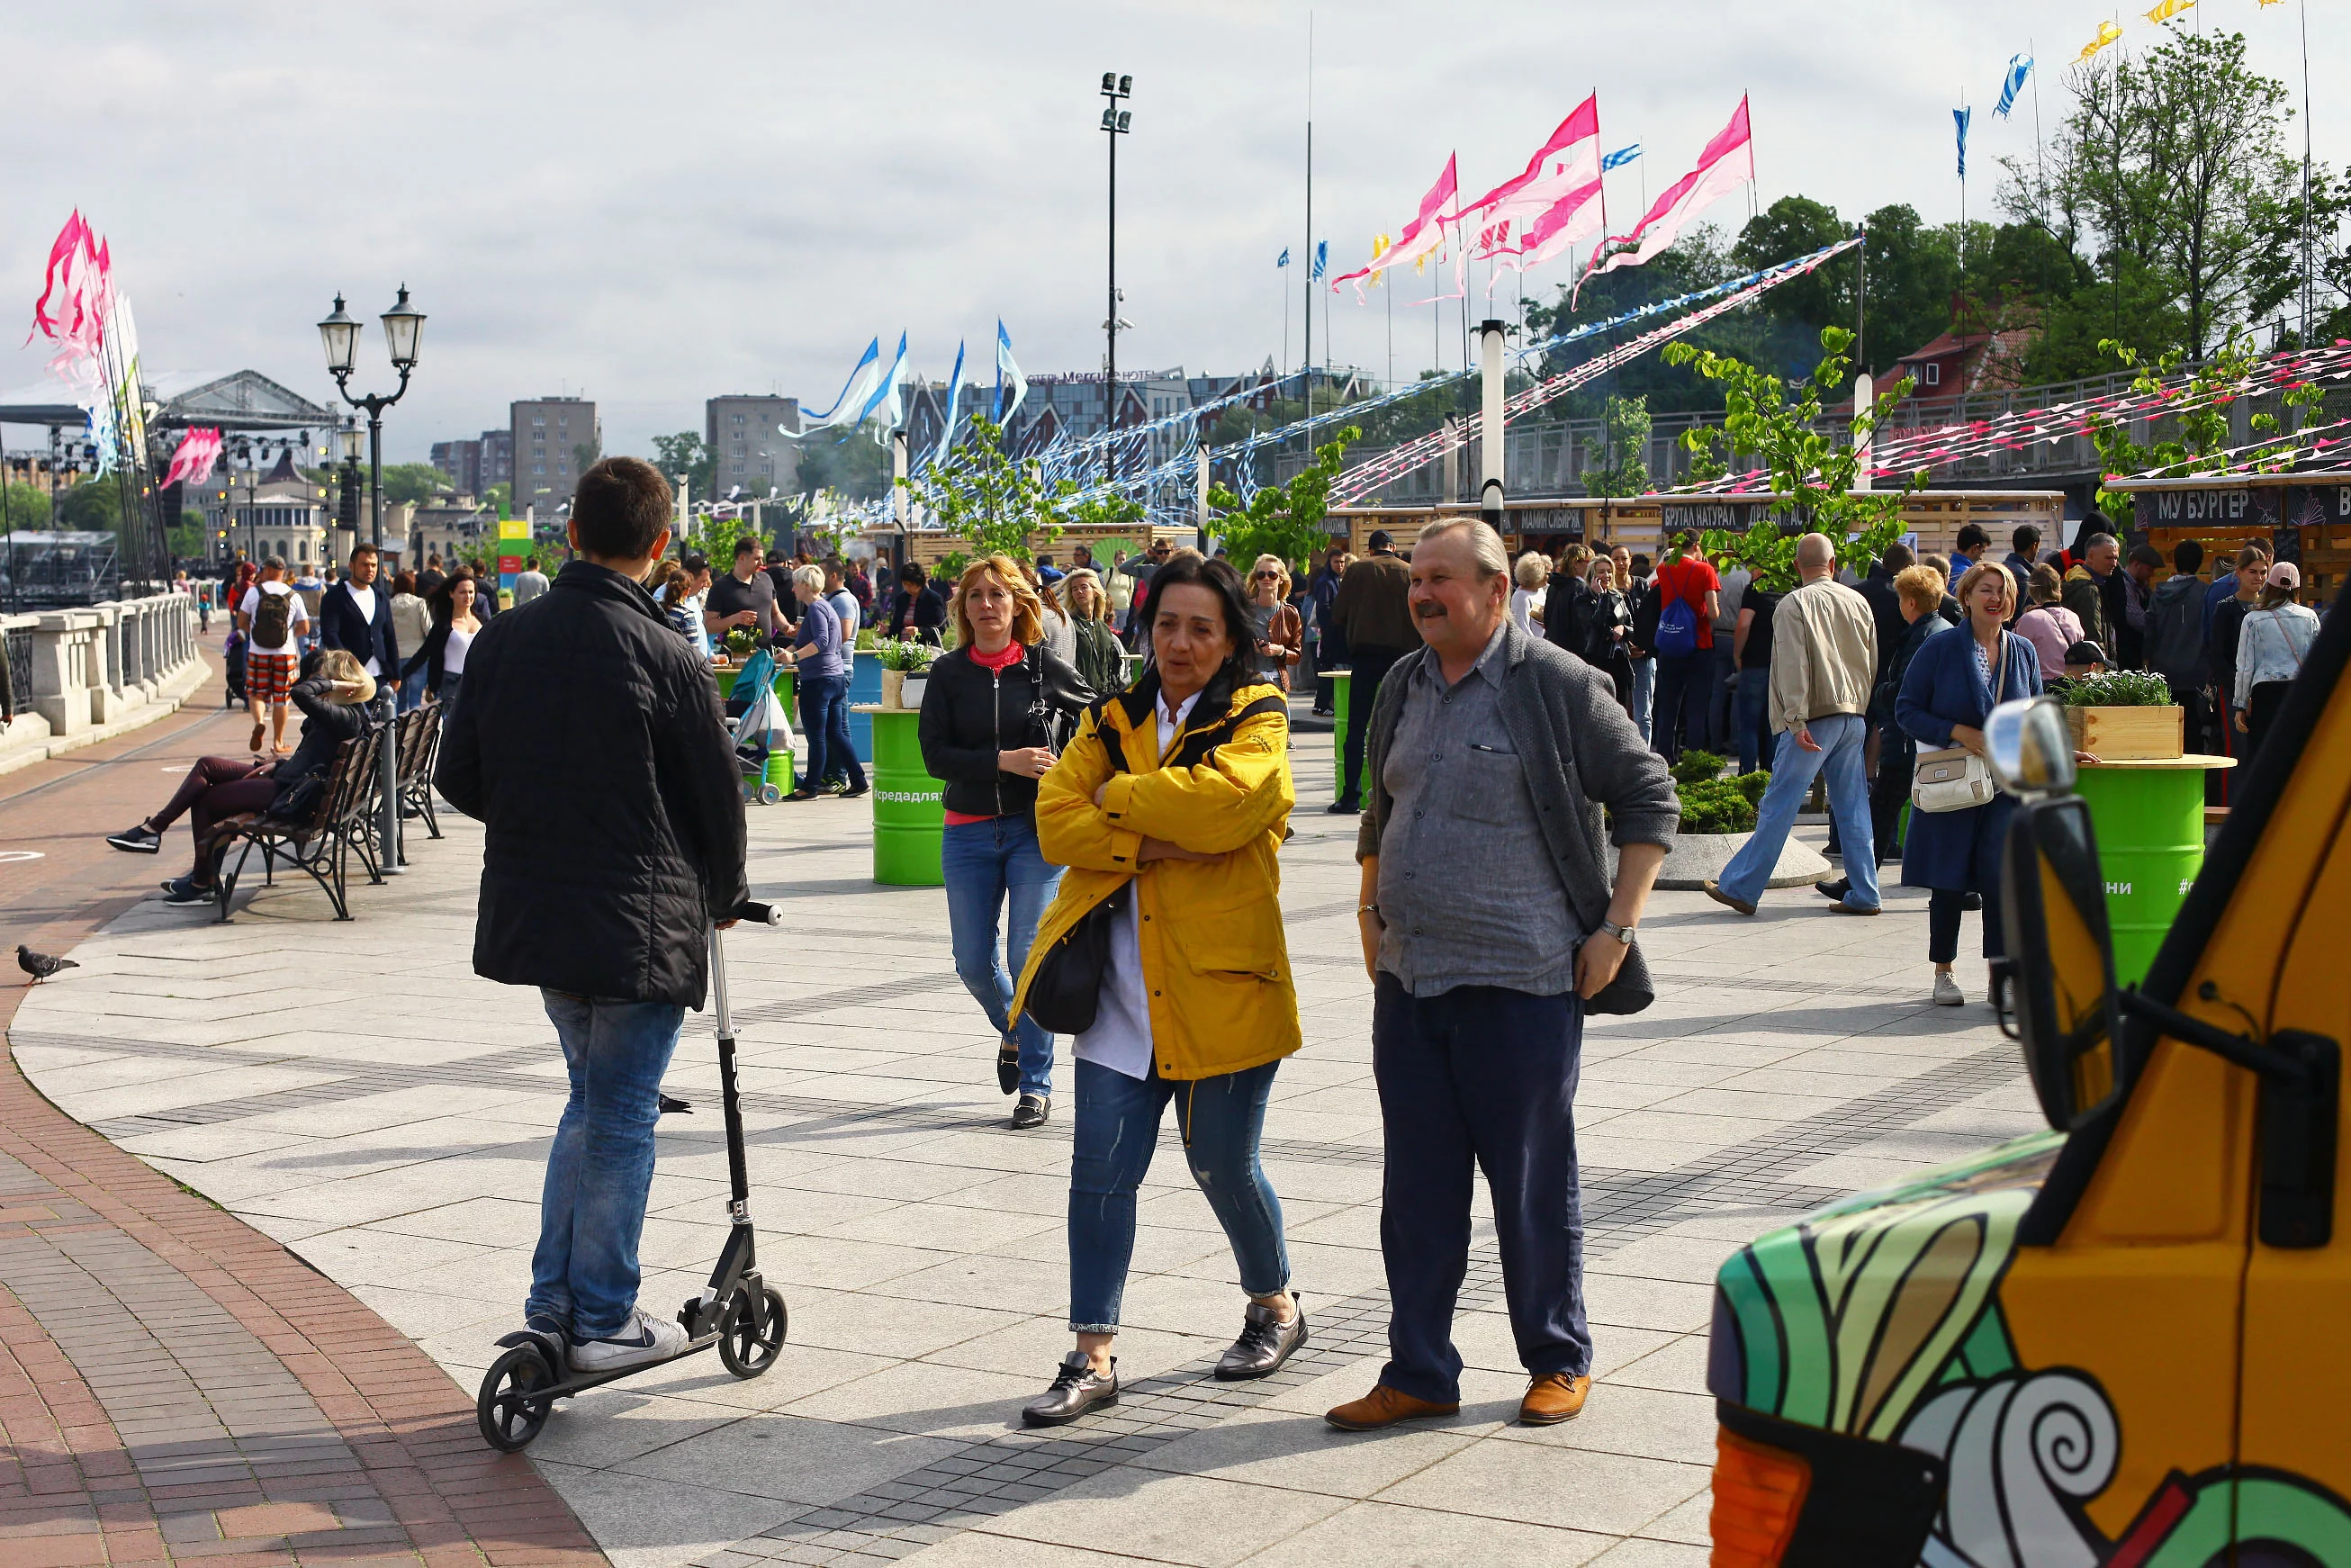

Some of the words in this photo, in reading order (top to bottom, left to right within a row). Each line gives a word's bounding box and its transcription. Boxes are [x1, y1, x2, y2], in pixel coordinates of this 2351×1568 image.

[1062, 370, 1121, 383] Mercue
[2158, 492, 2183, 519] МУ
[2187, 489, 2249, 519] БУРГЕР
[1521, 509, 1547, 529] МАМИН
[1548, 509, 1581, 529] СИБИРЯК
[1665, 506, 1695, 527] БРУТАЛ
[1696, 505, 1736, 526] НАТУРАЛ
